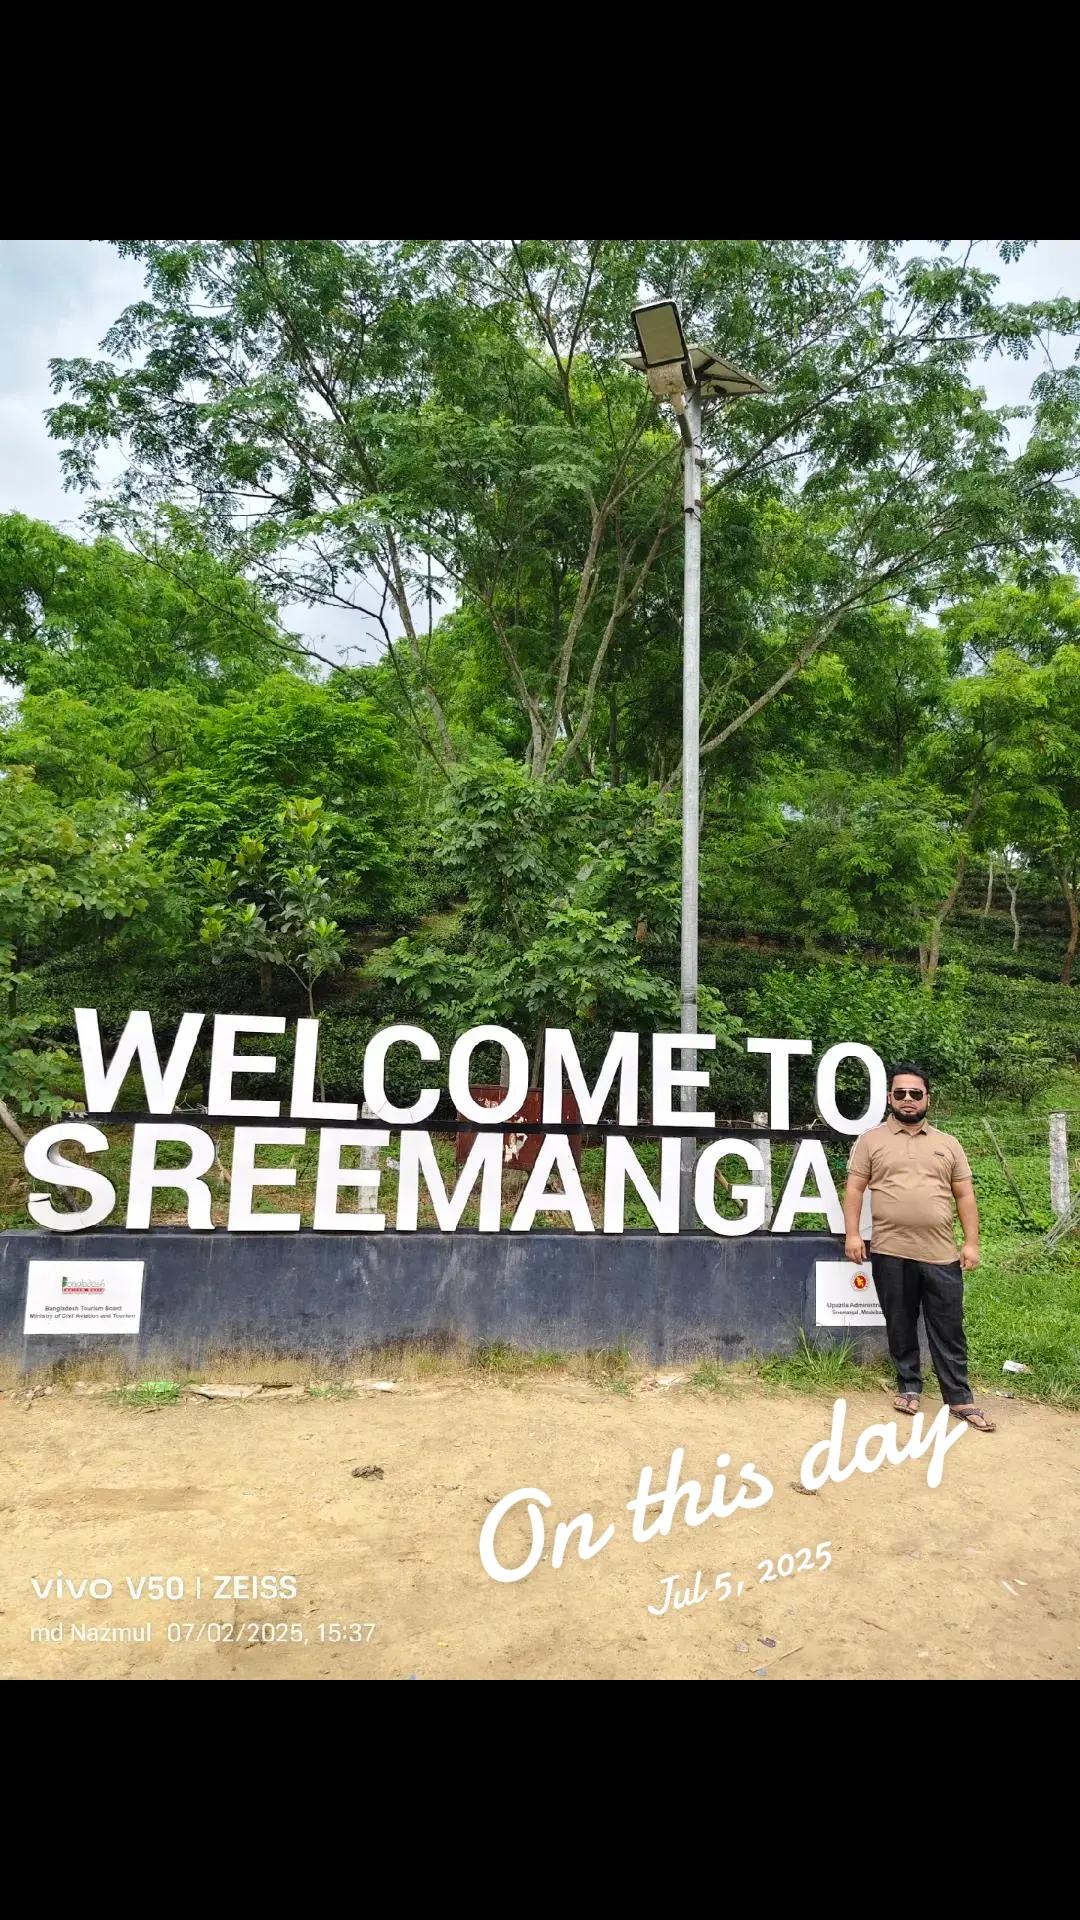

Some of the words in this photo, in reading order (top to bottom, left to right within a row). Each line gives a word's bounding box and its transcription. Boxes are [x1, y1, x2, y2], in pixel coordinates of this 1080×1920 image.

[74, 1007, 716, 1128] WELCOME
[747, 1037, 887, 1136] TO
[23, 1121, 873, 1241] SREEMANGA
